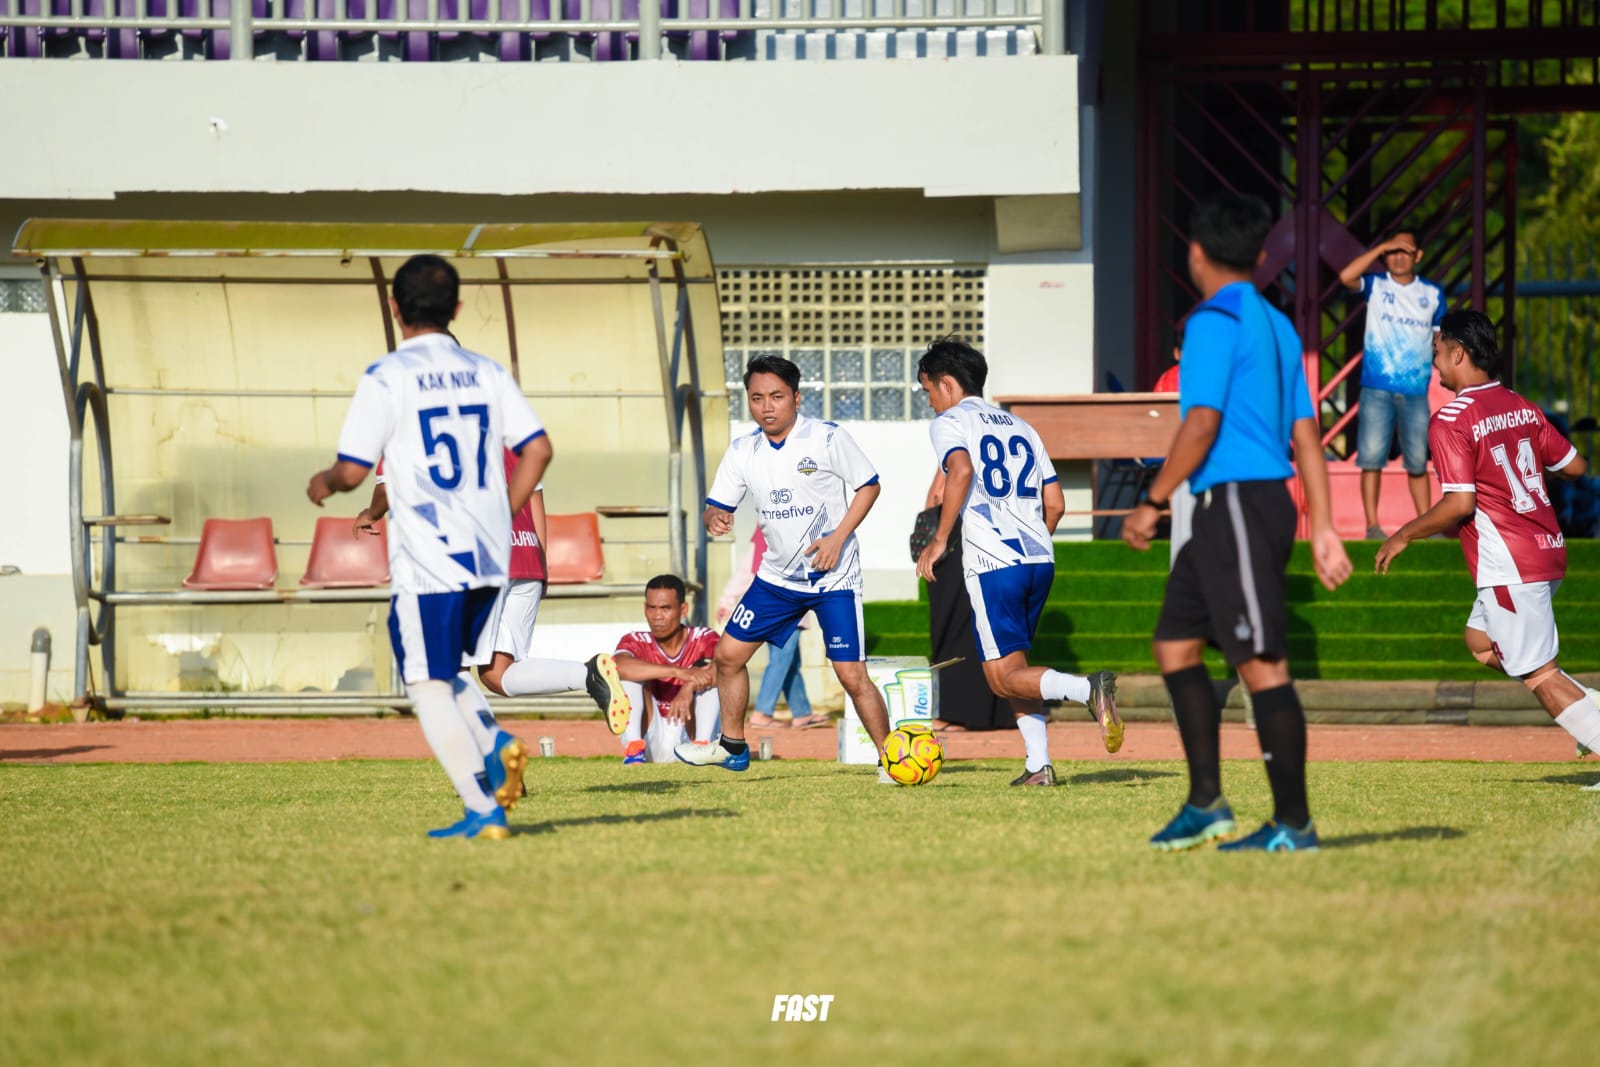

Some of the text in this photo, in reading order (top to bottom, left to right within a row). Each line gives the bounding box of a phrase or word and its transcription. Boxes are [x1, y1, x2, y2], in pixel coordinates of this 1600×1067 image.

[416, 371, 480, 391] KAK NUK
[979, 413, 1014, 426] C-MAD
[418, 403, 490, 491] 57
[980, 434, 1038, 499] 82
[1490, 437, 1551, 514] 14
[731, 603, 755, 630] 08
[913, 684, 929, 716] flow
